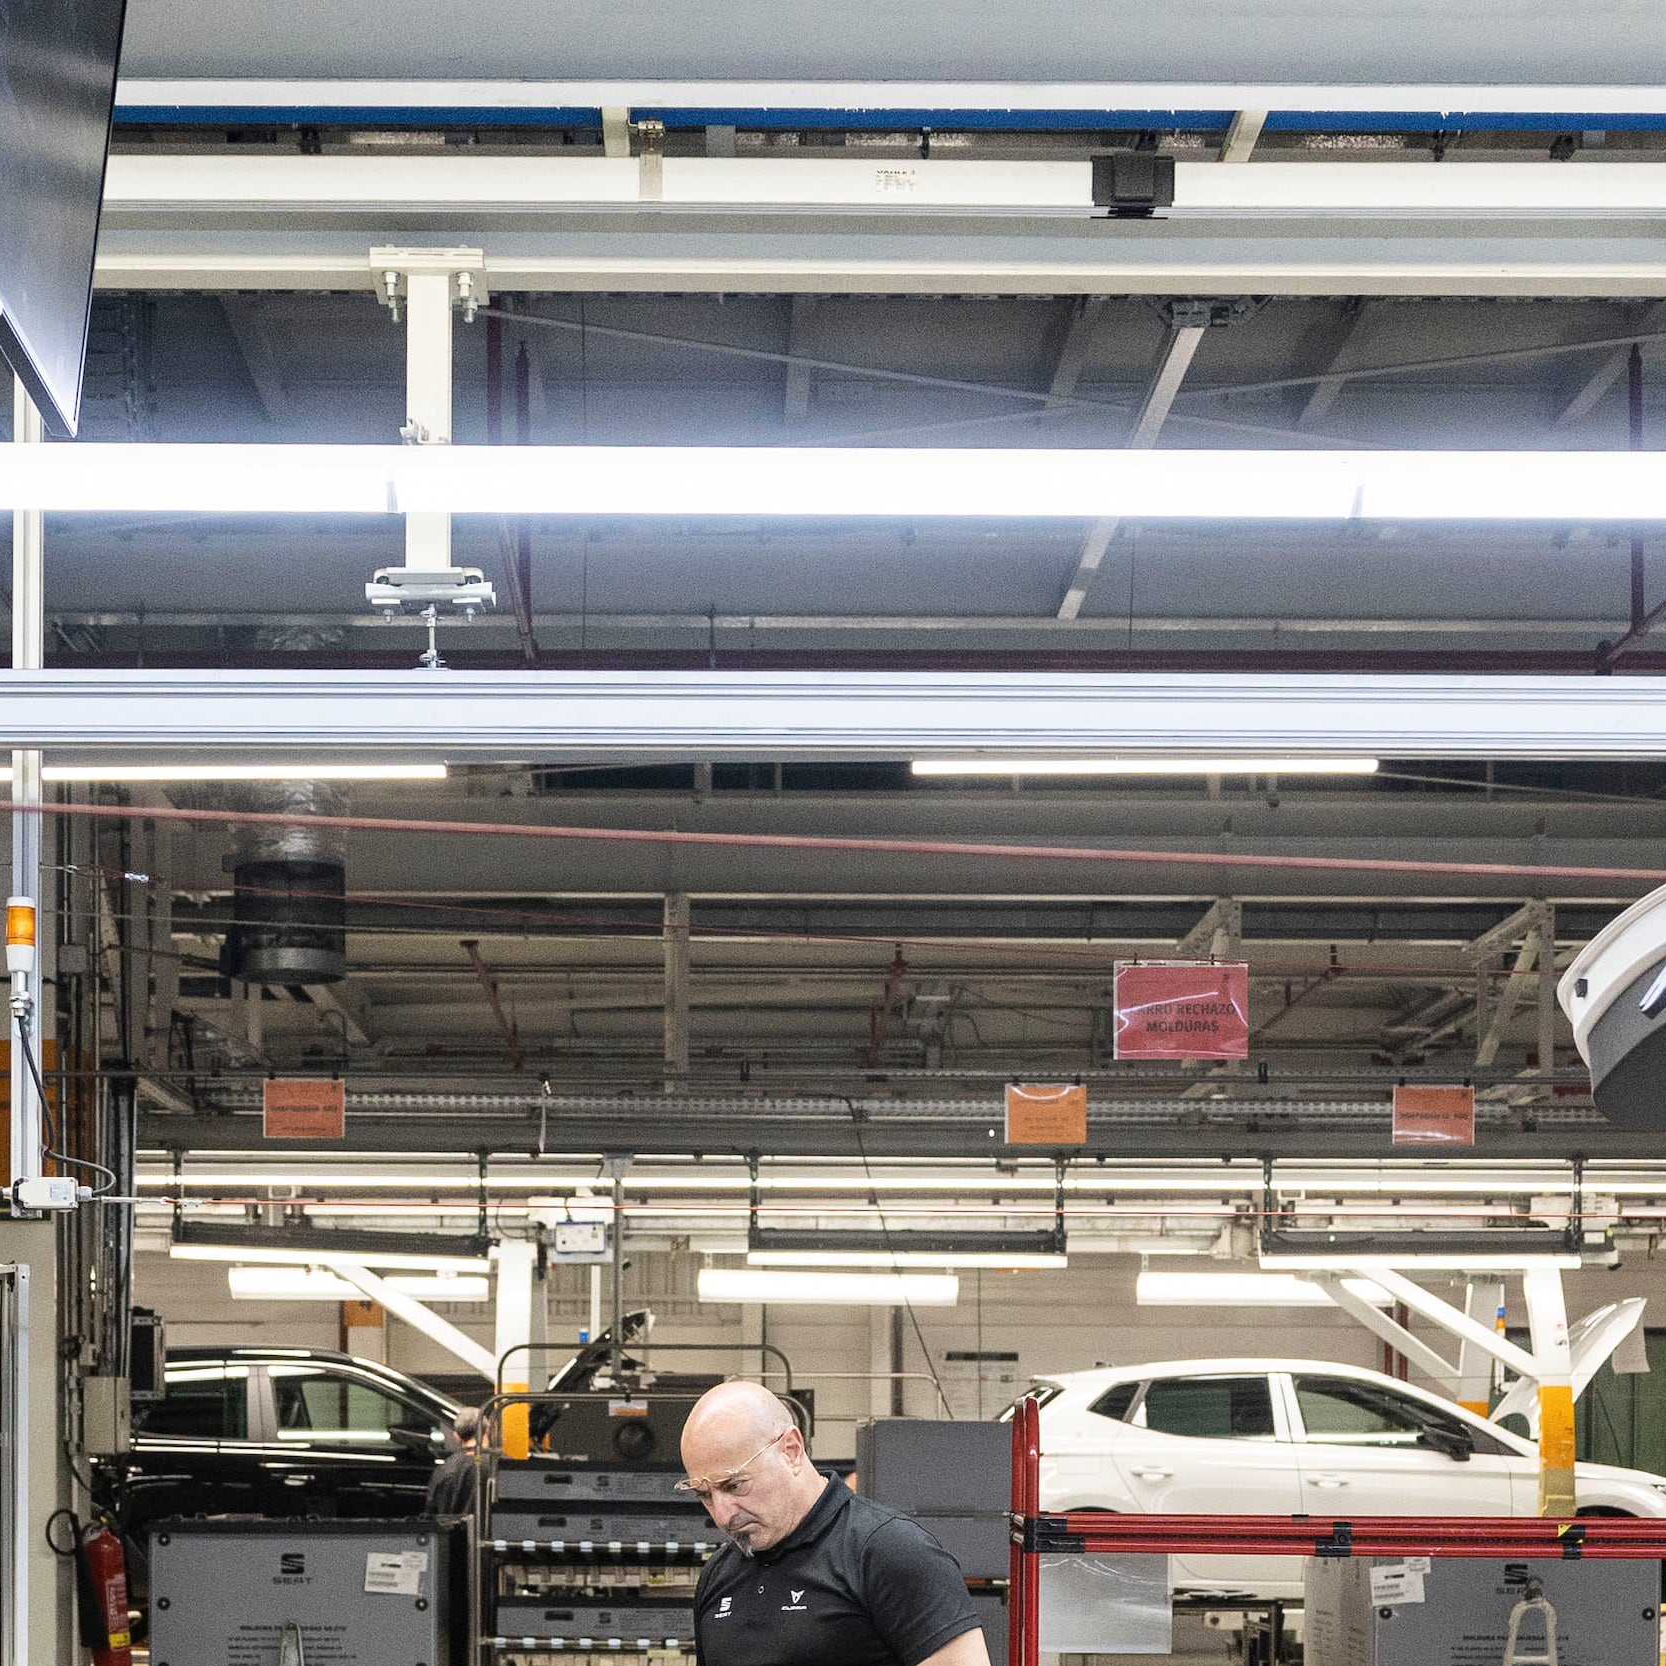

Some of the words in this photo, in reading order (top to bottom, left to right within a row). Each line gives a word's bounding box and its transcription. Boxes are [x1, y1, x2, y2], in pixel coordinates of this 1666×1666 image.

[1177, 1003, 1236, 1016] RECHAZO
[1146, 1020, 1219, 1032] MOLDURAS
[272, 1577, 314, 1585] SEAT
